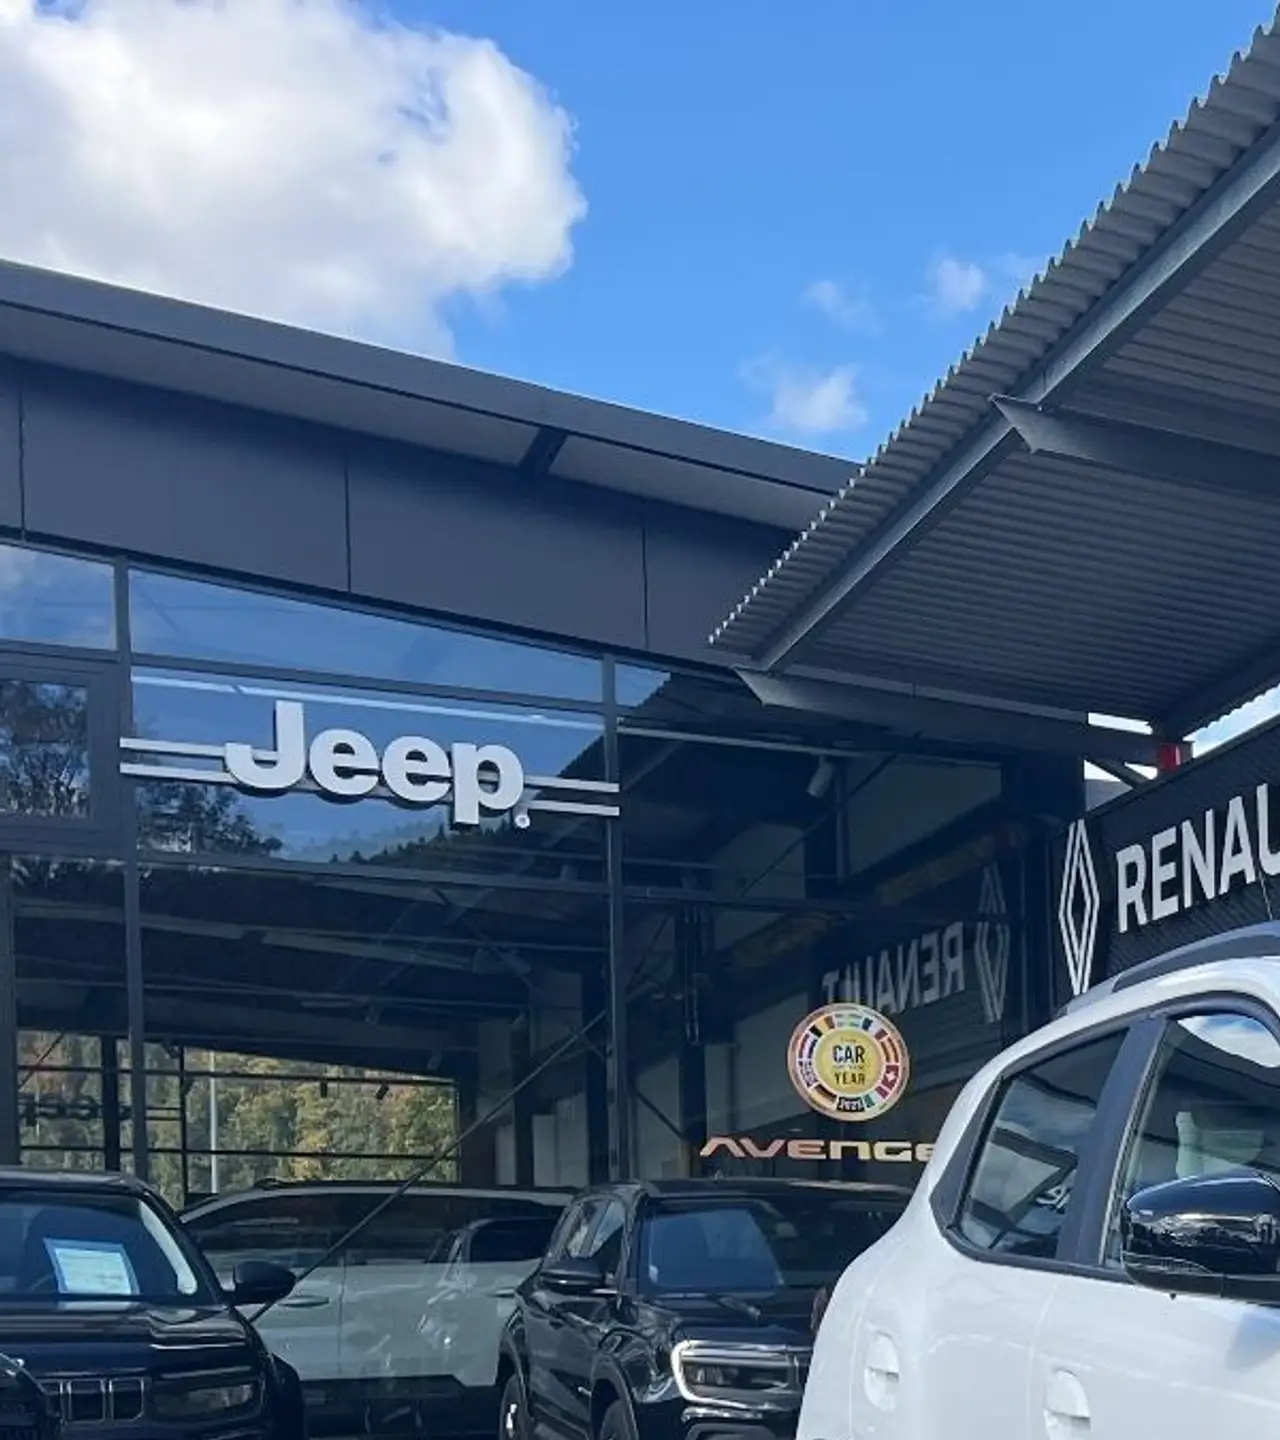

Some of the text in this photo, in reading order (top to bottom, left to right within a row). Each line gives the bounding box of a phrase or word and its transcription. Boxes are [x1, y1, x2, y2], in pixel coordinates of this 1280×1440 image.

[223, 700, 525, 825] Jeep
[832, 1045, 866, 1063] CAR
[834, 1071, 866, 1085] YEAR
